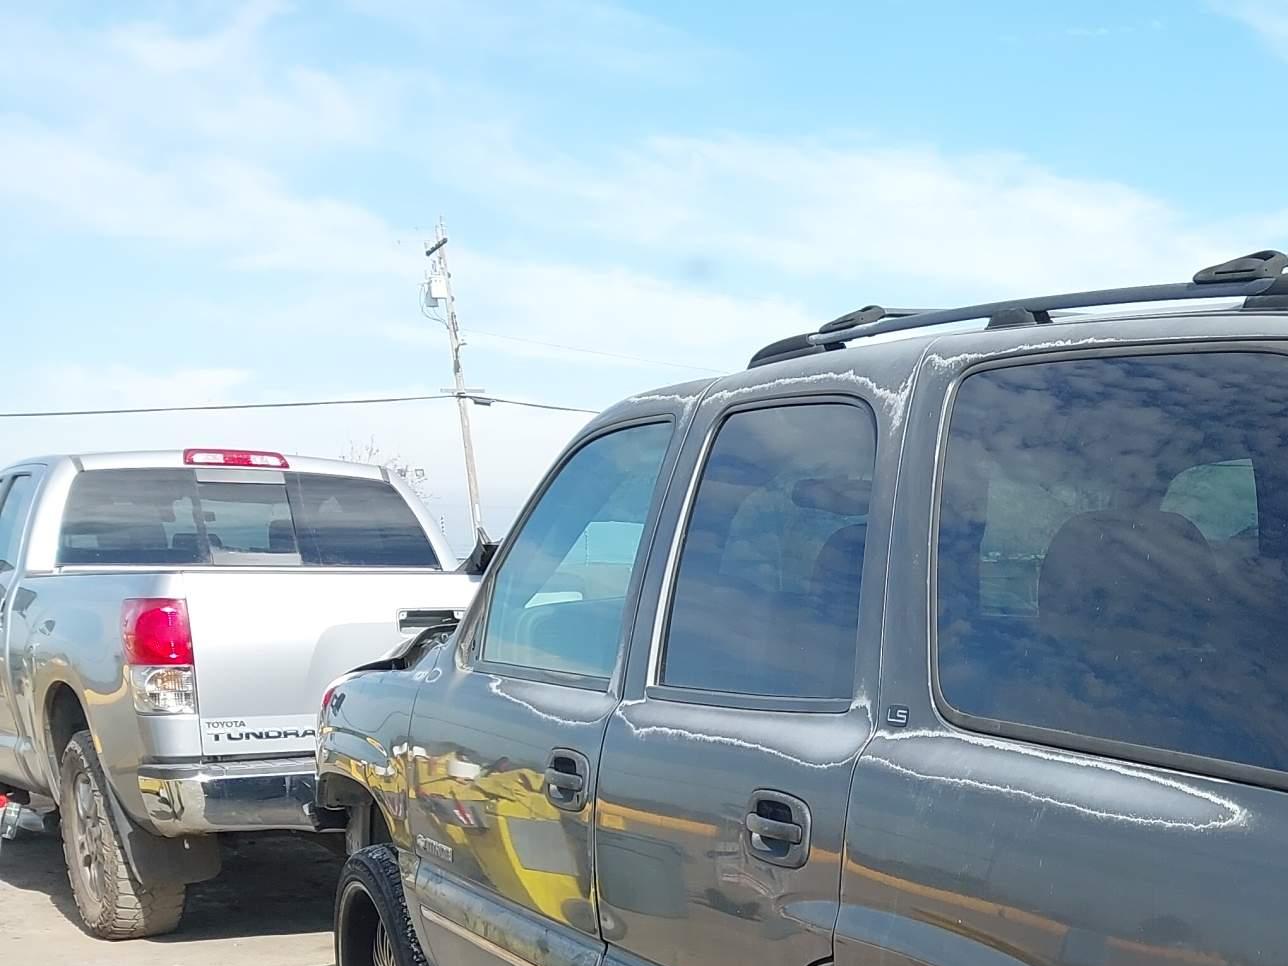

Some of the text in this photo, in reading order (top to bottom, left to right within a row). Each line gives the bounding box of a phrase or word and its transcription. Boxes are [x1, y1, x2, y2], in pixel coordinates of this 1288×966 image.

[887, 708, 908, 723] LS
[206, 720, 246, 729] TOYOTA
[207, 729, 316, 741] TUNDRA
